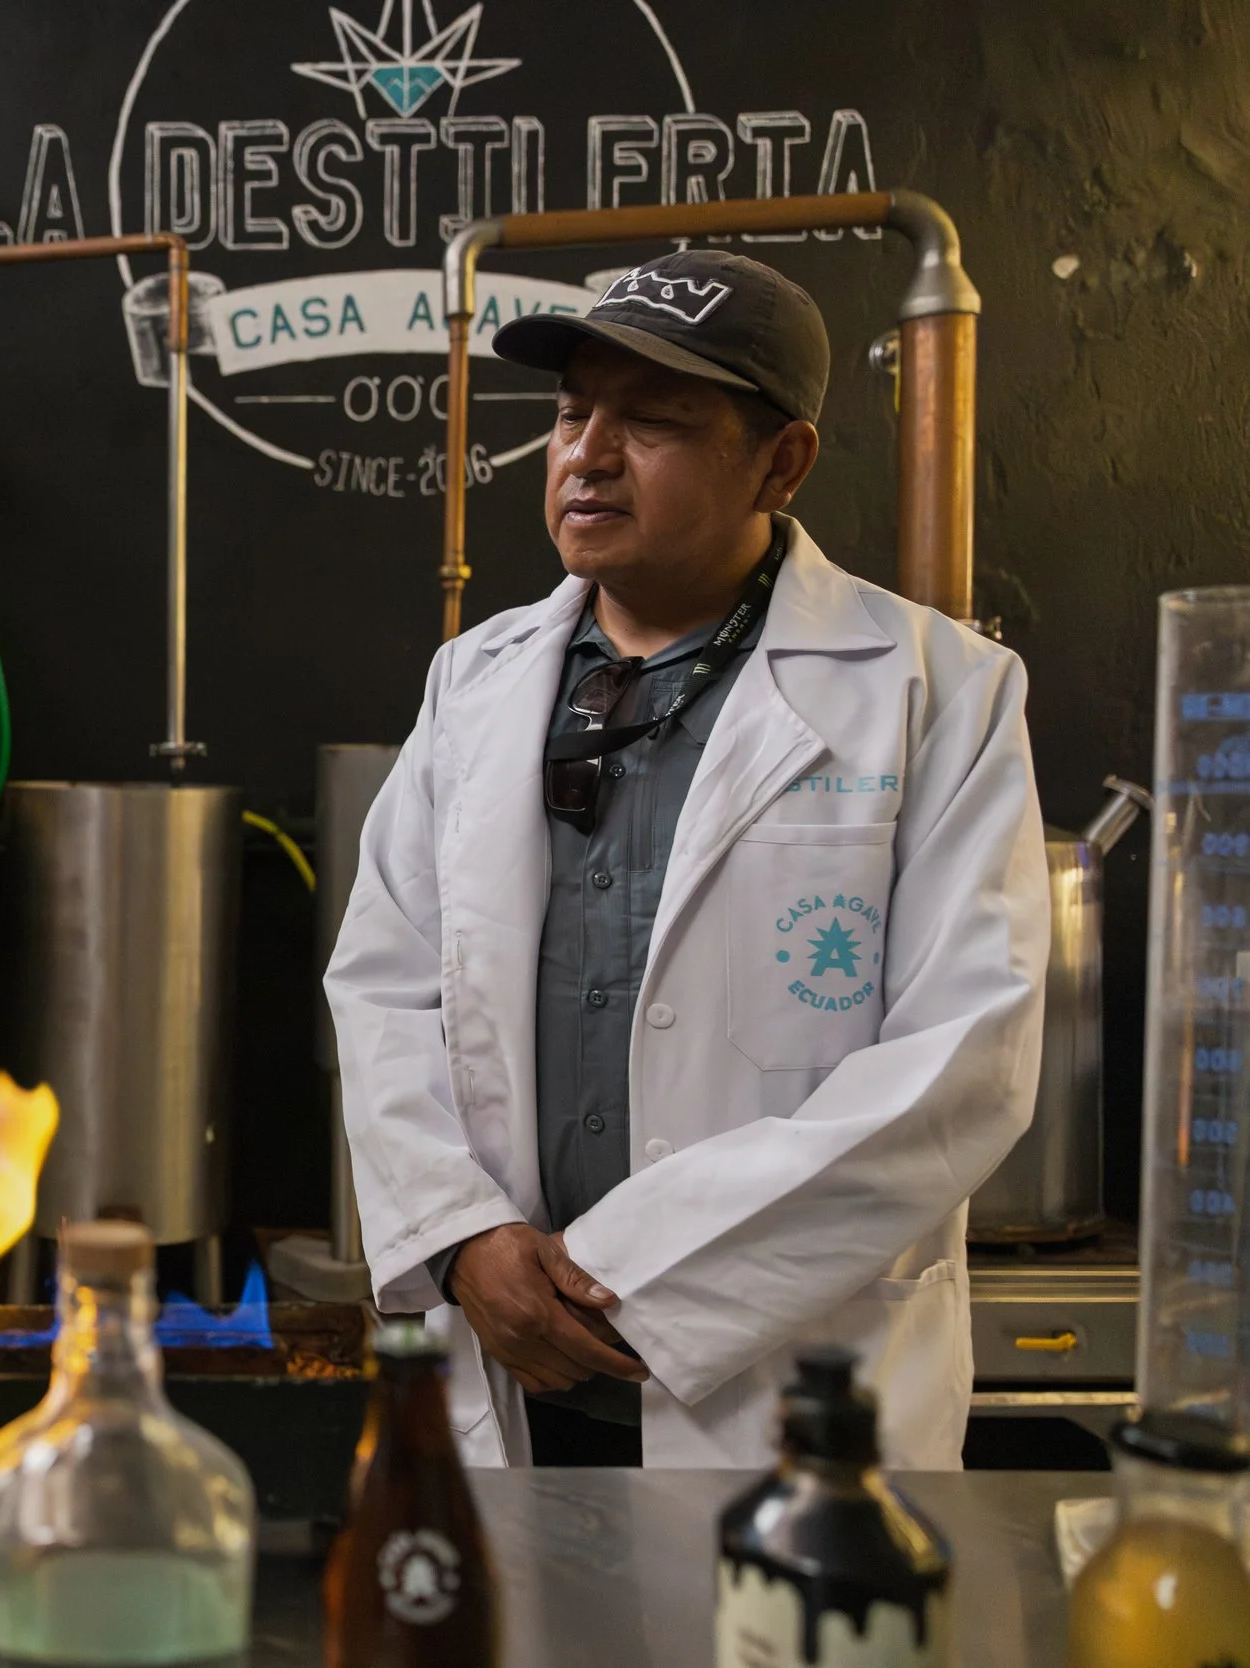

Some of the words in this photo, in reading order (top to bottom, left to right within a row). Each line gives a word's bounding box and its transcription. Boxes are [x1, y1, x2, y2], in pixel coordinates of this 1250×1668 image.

[230, 294, 366, 350] CASA
[713, 603, 751, 646] MONSTER
[776, 895, 826, 933] CASA
[832, 893, 883, 934] AGAVE
[787, 979, 875, 1012] ECUADOR
